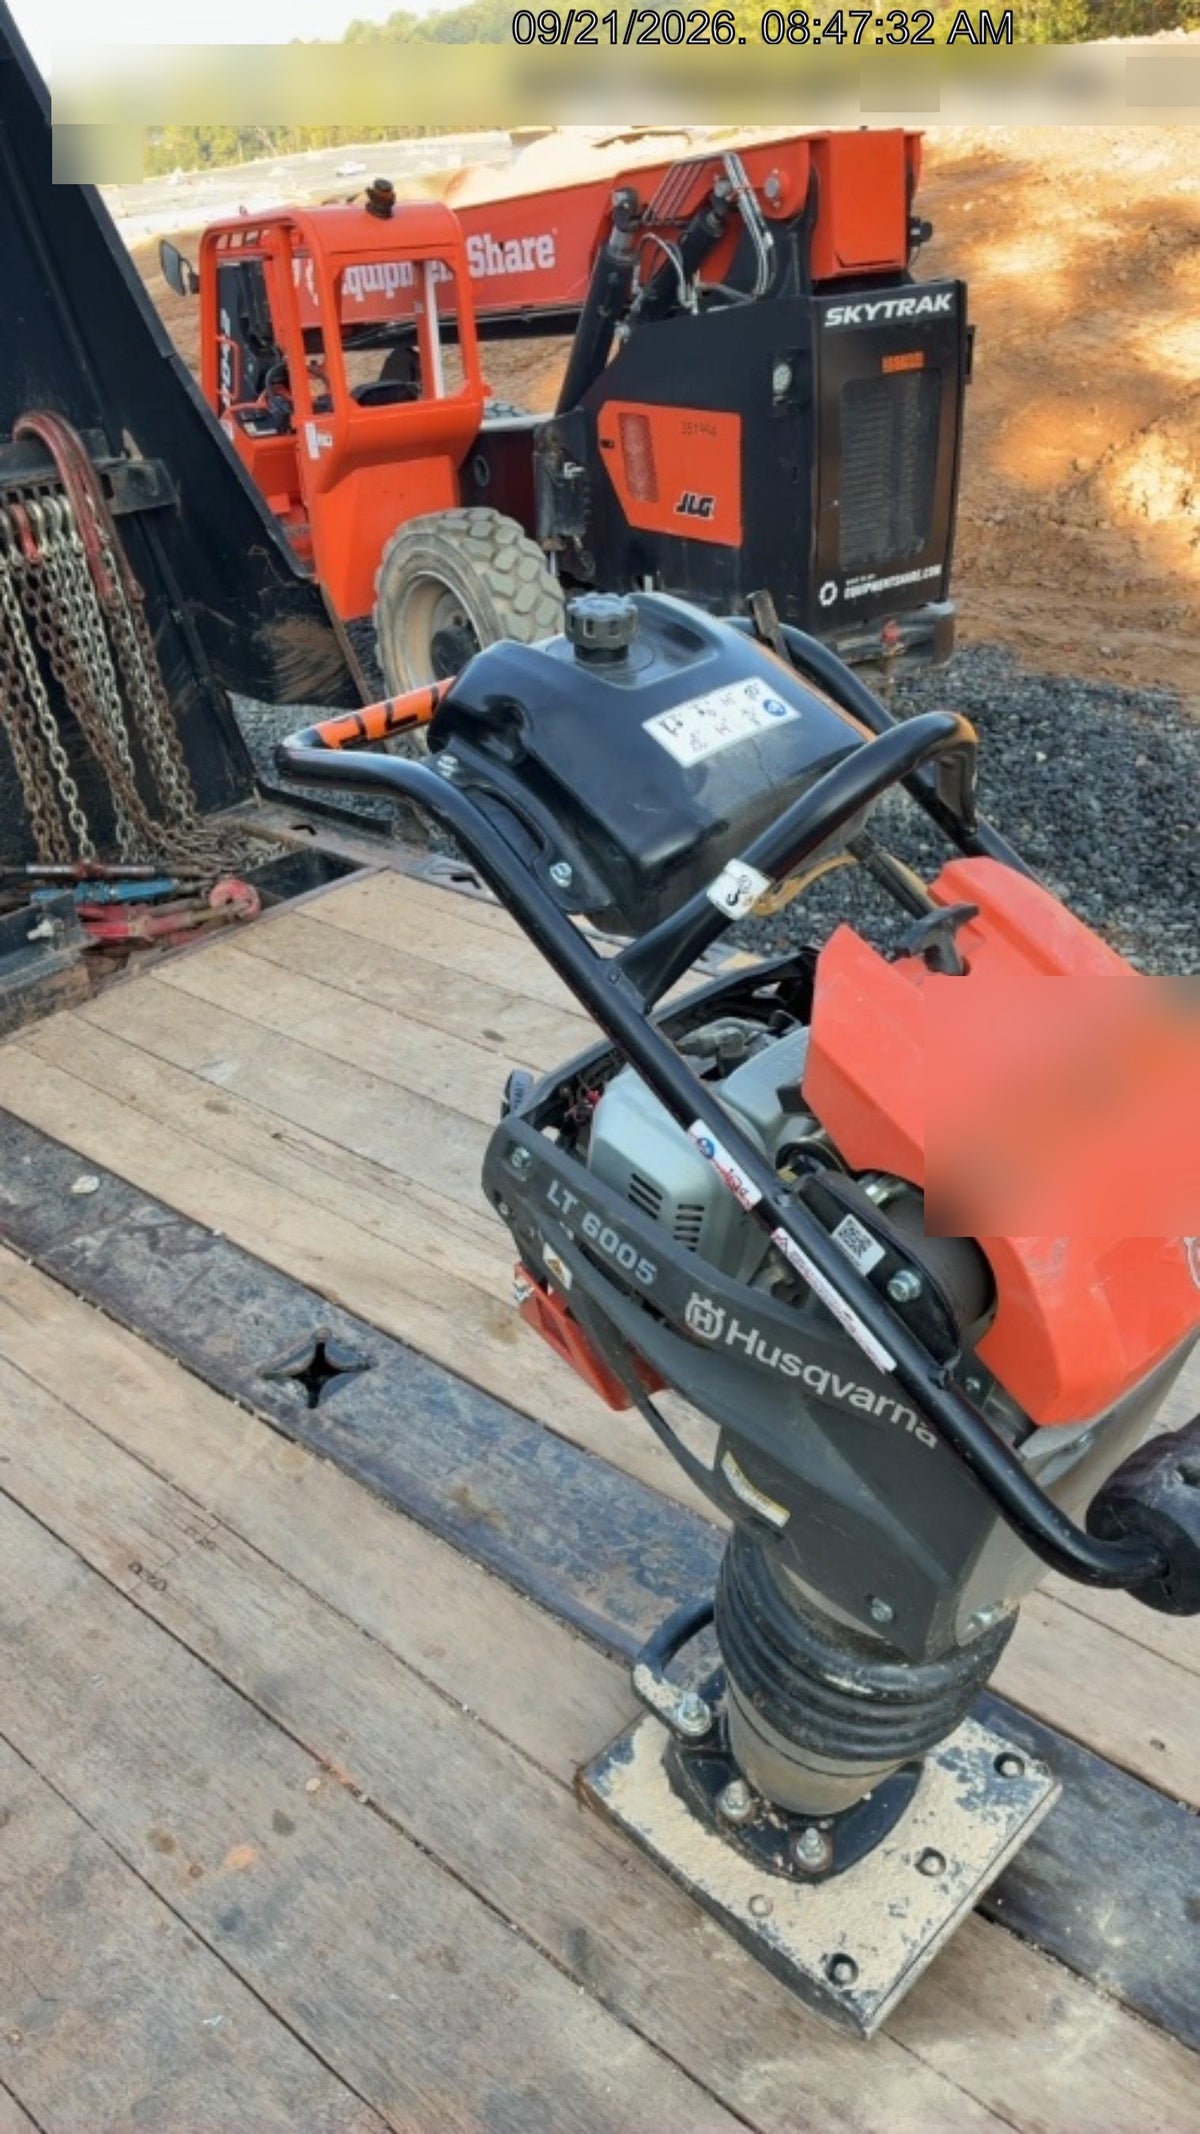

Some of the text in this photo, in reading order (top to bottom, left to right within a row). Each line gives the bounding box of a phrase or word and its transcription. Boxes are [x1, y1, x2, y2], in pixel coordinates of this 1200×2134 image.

[824, 293, 953, 328] SKYTRAK
[674, 491, 715, 519] JLG
[547, 1179, 658, 1286] LT 6005
[725, 1317, 938, 1449] Husqvarna
